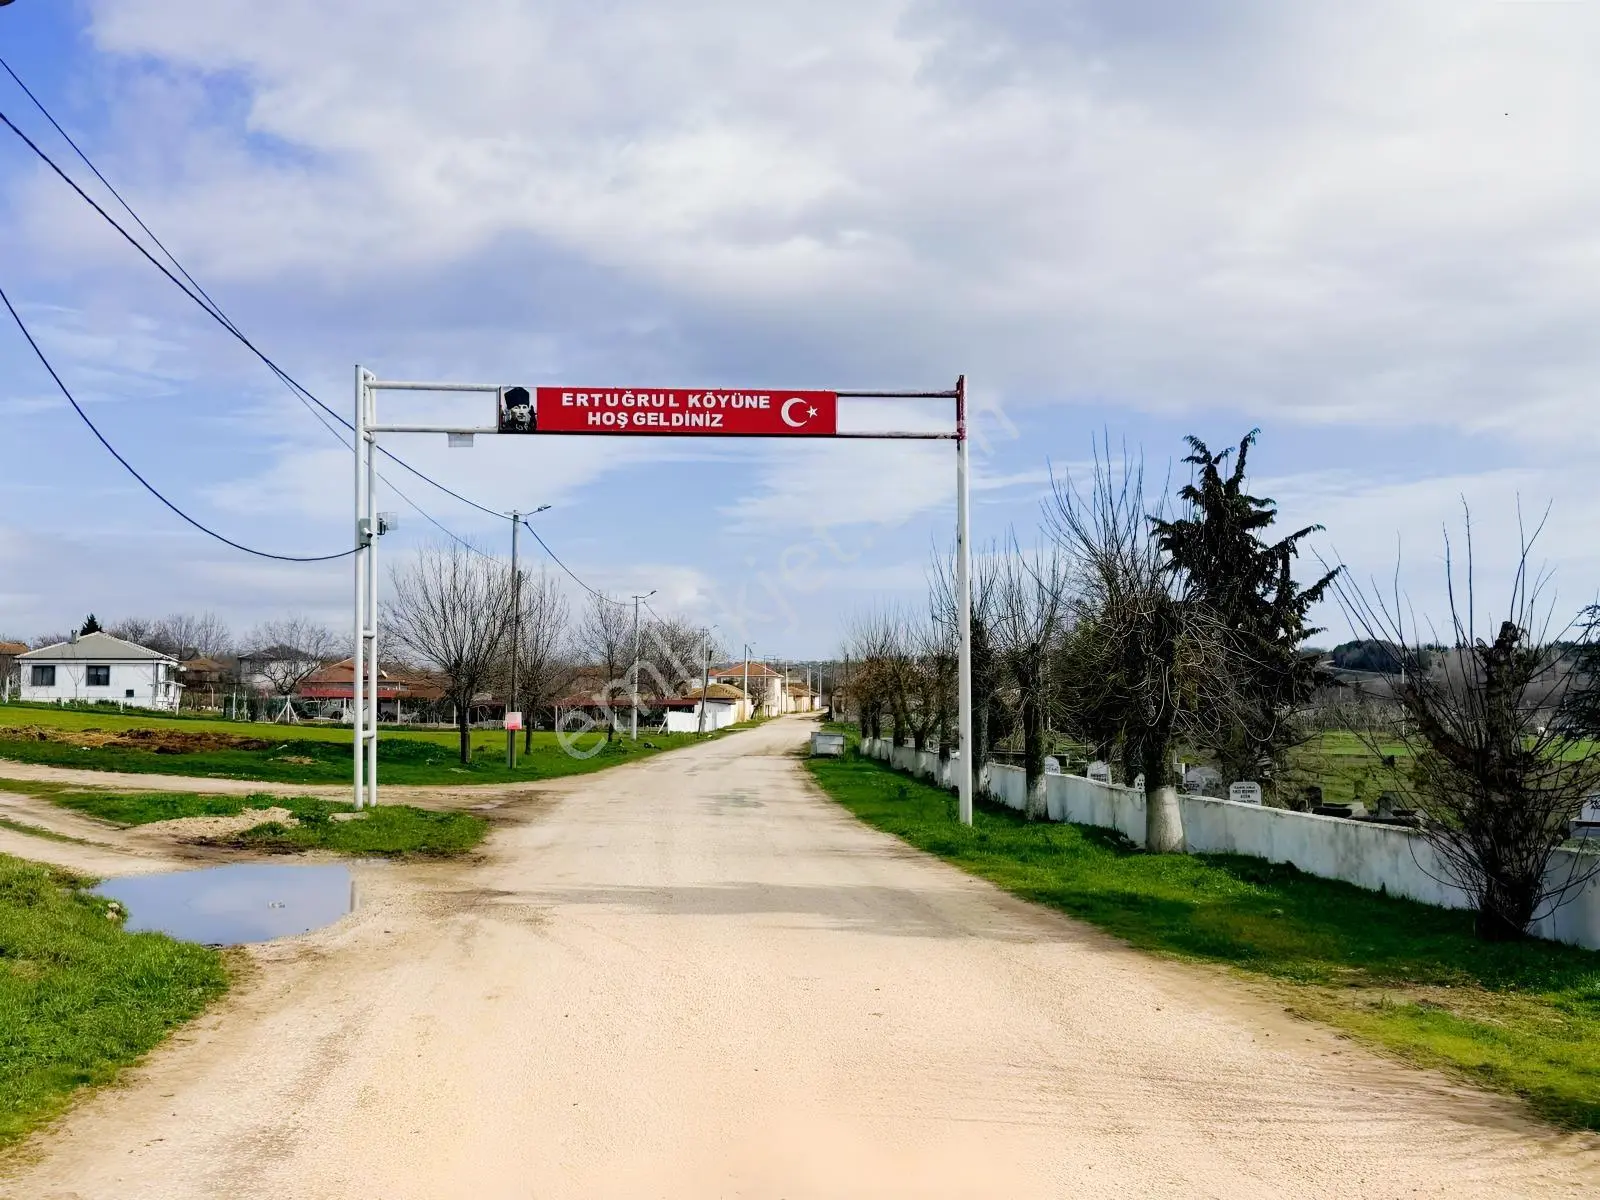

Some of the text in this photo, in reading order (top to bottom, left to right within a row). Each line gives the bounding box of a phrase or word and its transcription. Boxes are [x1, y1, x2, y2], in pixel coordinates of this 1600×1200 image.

[561, 390, 771, 409] ERTUĞRUL KÖYÜNE
[587, 410, 724, 429] HOŞ GELDİNİZ
